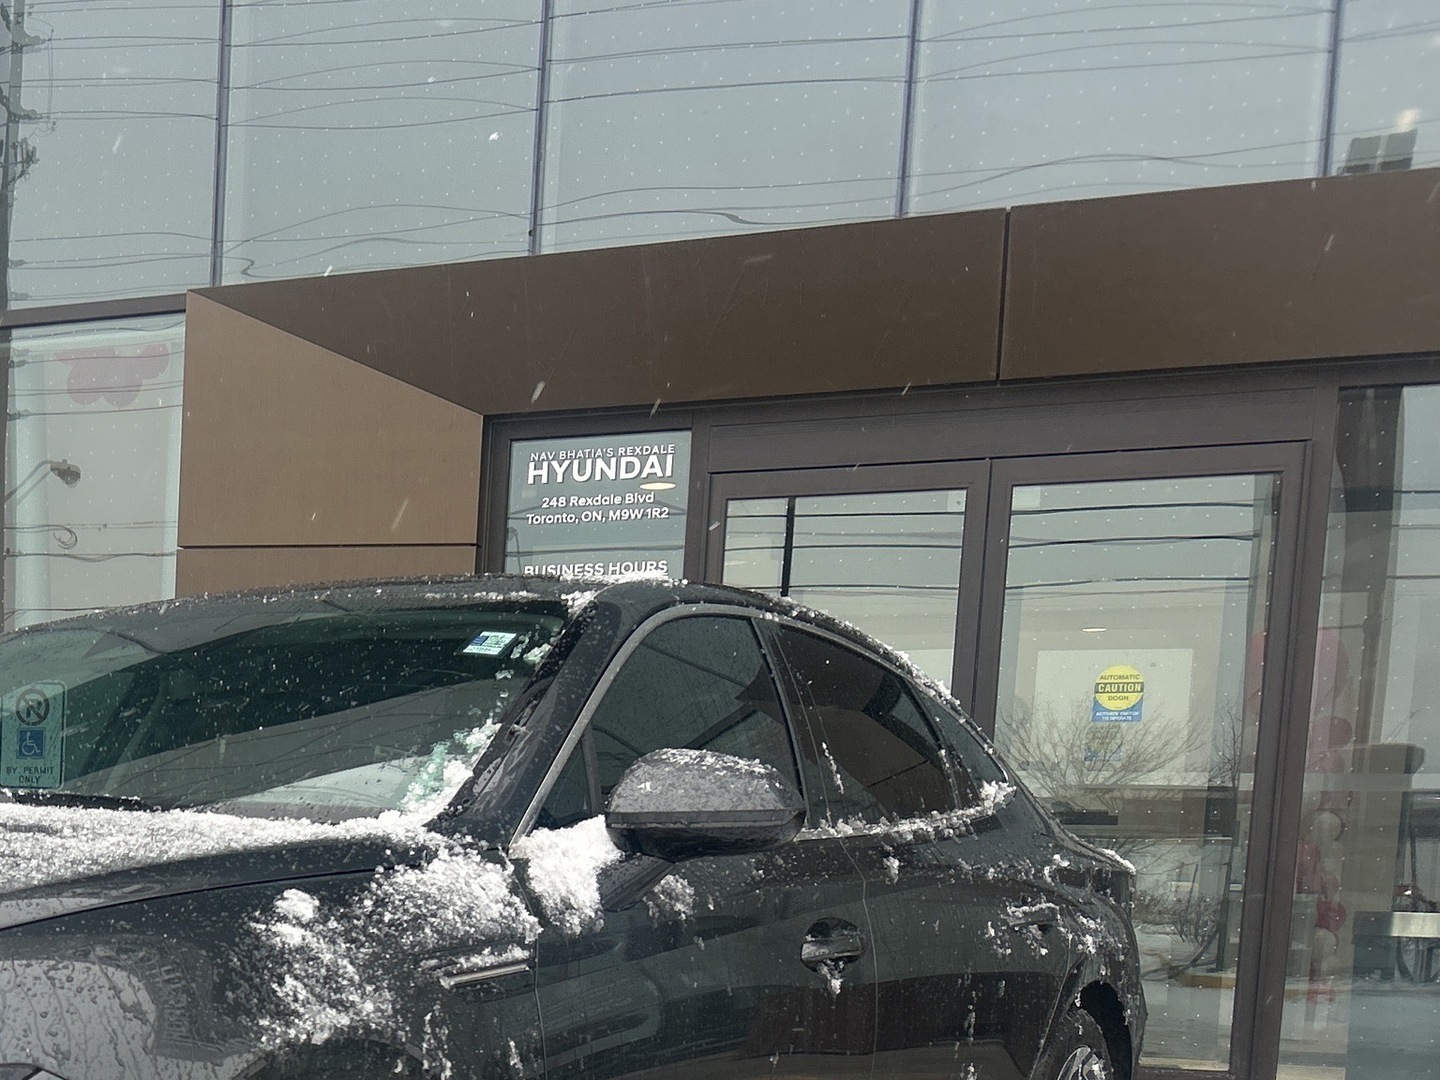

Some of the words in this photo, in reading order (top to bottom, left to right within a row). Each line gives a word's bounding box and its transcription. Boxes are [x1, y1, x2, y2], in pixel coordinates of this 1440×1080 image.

[530, 451, 556, 462] NAV
[559, 447, 614, 460] BHATIA'S
[618, 444, 675, 456] REXDALE
[527, 454, 674, 485] HYUNDAI
[541, 496, 567, 508] 248
[569, 493, 622, 507] Rexdale
[625, 491, 655, 504] Blvd
[526, 513, 579, 525] Toronto,
[581, 511, 606, 523] ON,
[608, 508, 644, 521] M9W
[645, 507, 669, 519] 1R2
[608, 560, 668, 576] HOURS
[1098, 683, 1141, 693] CAUTION
[6, 766, 18, 774] BY
